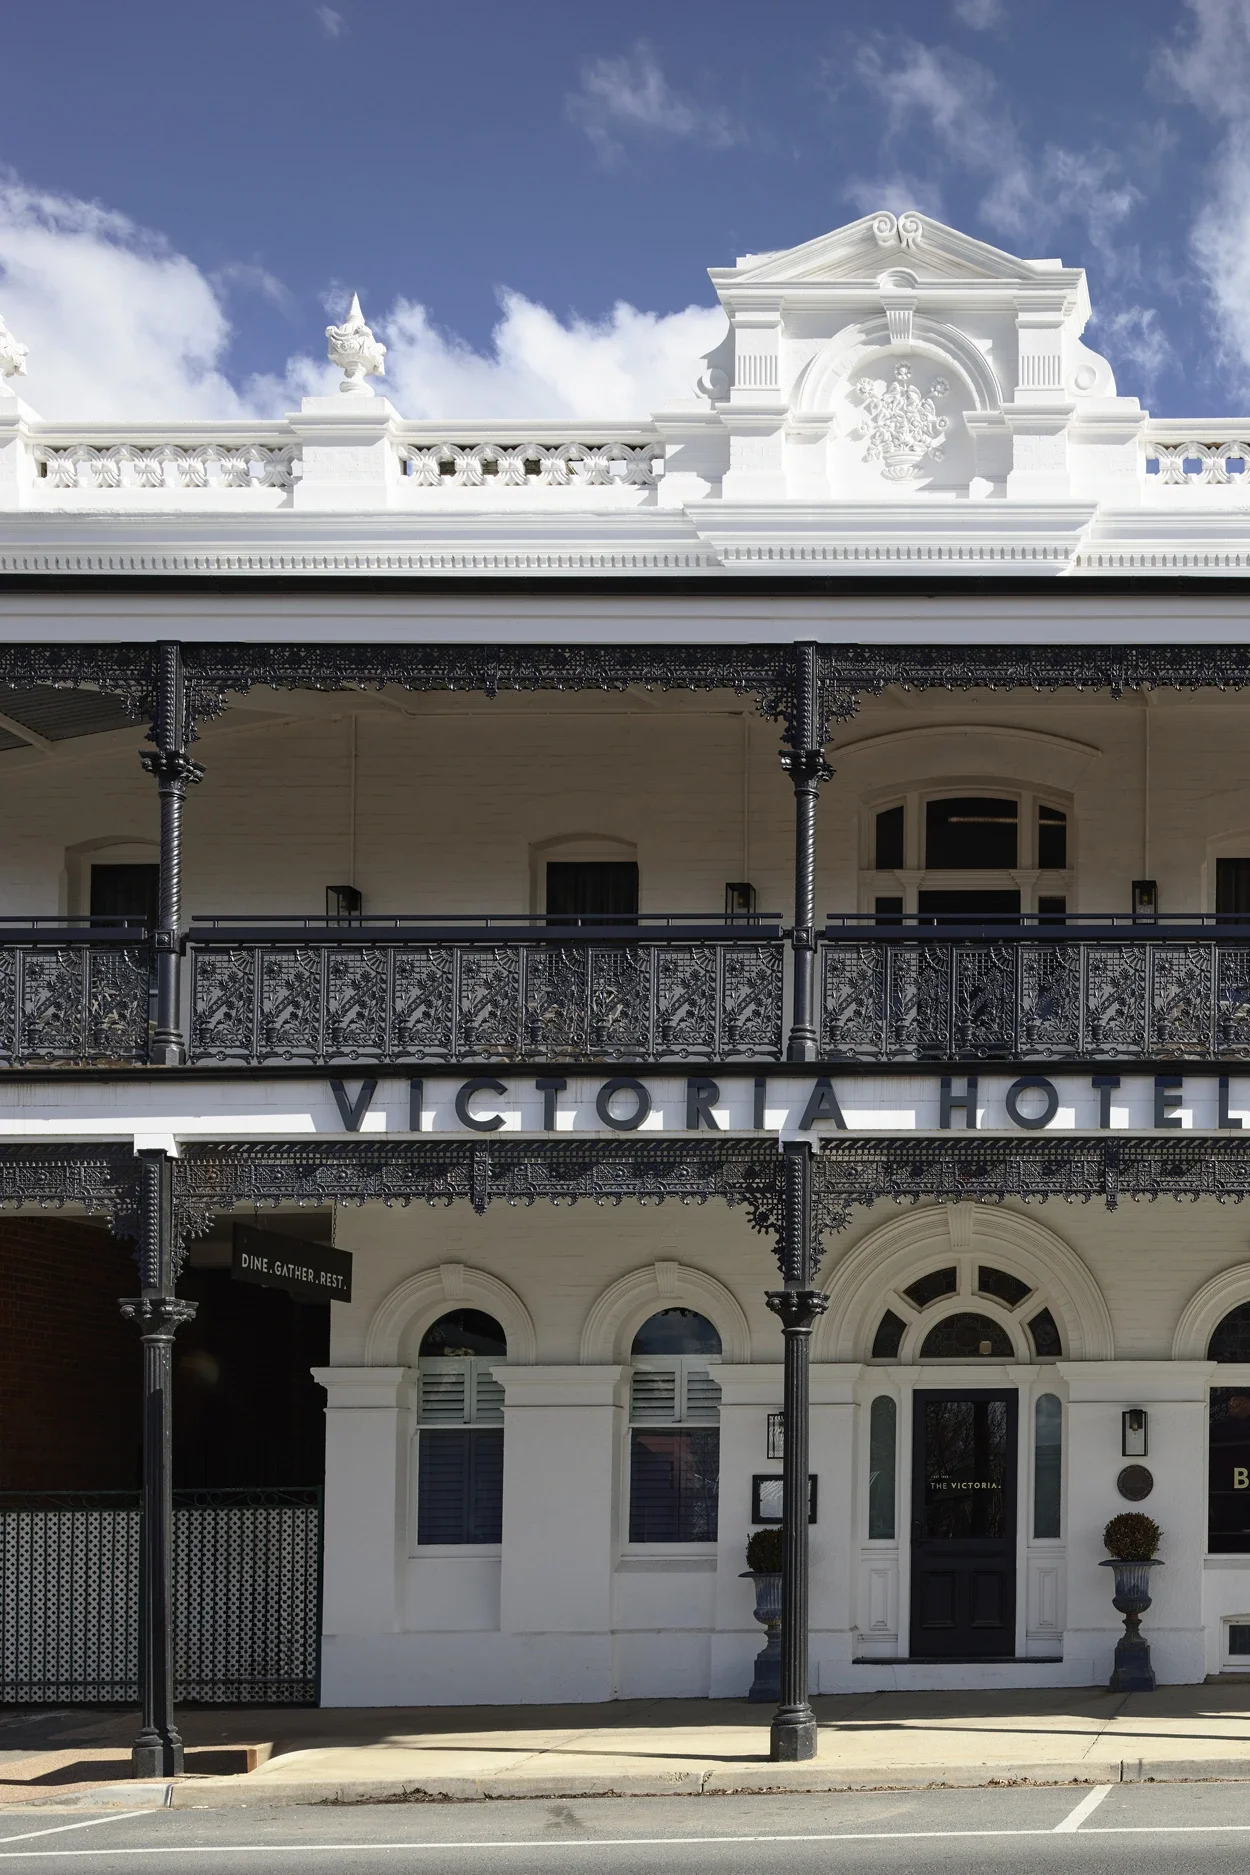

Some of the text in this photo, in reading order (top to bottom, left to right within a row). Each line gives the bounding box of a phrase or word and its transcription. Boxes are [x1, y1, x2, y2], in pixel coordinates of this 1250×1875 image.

[329, 1075, 1243, 1131] VICTORIA HOTEL
[930, 1482, 948, 1490] THE
